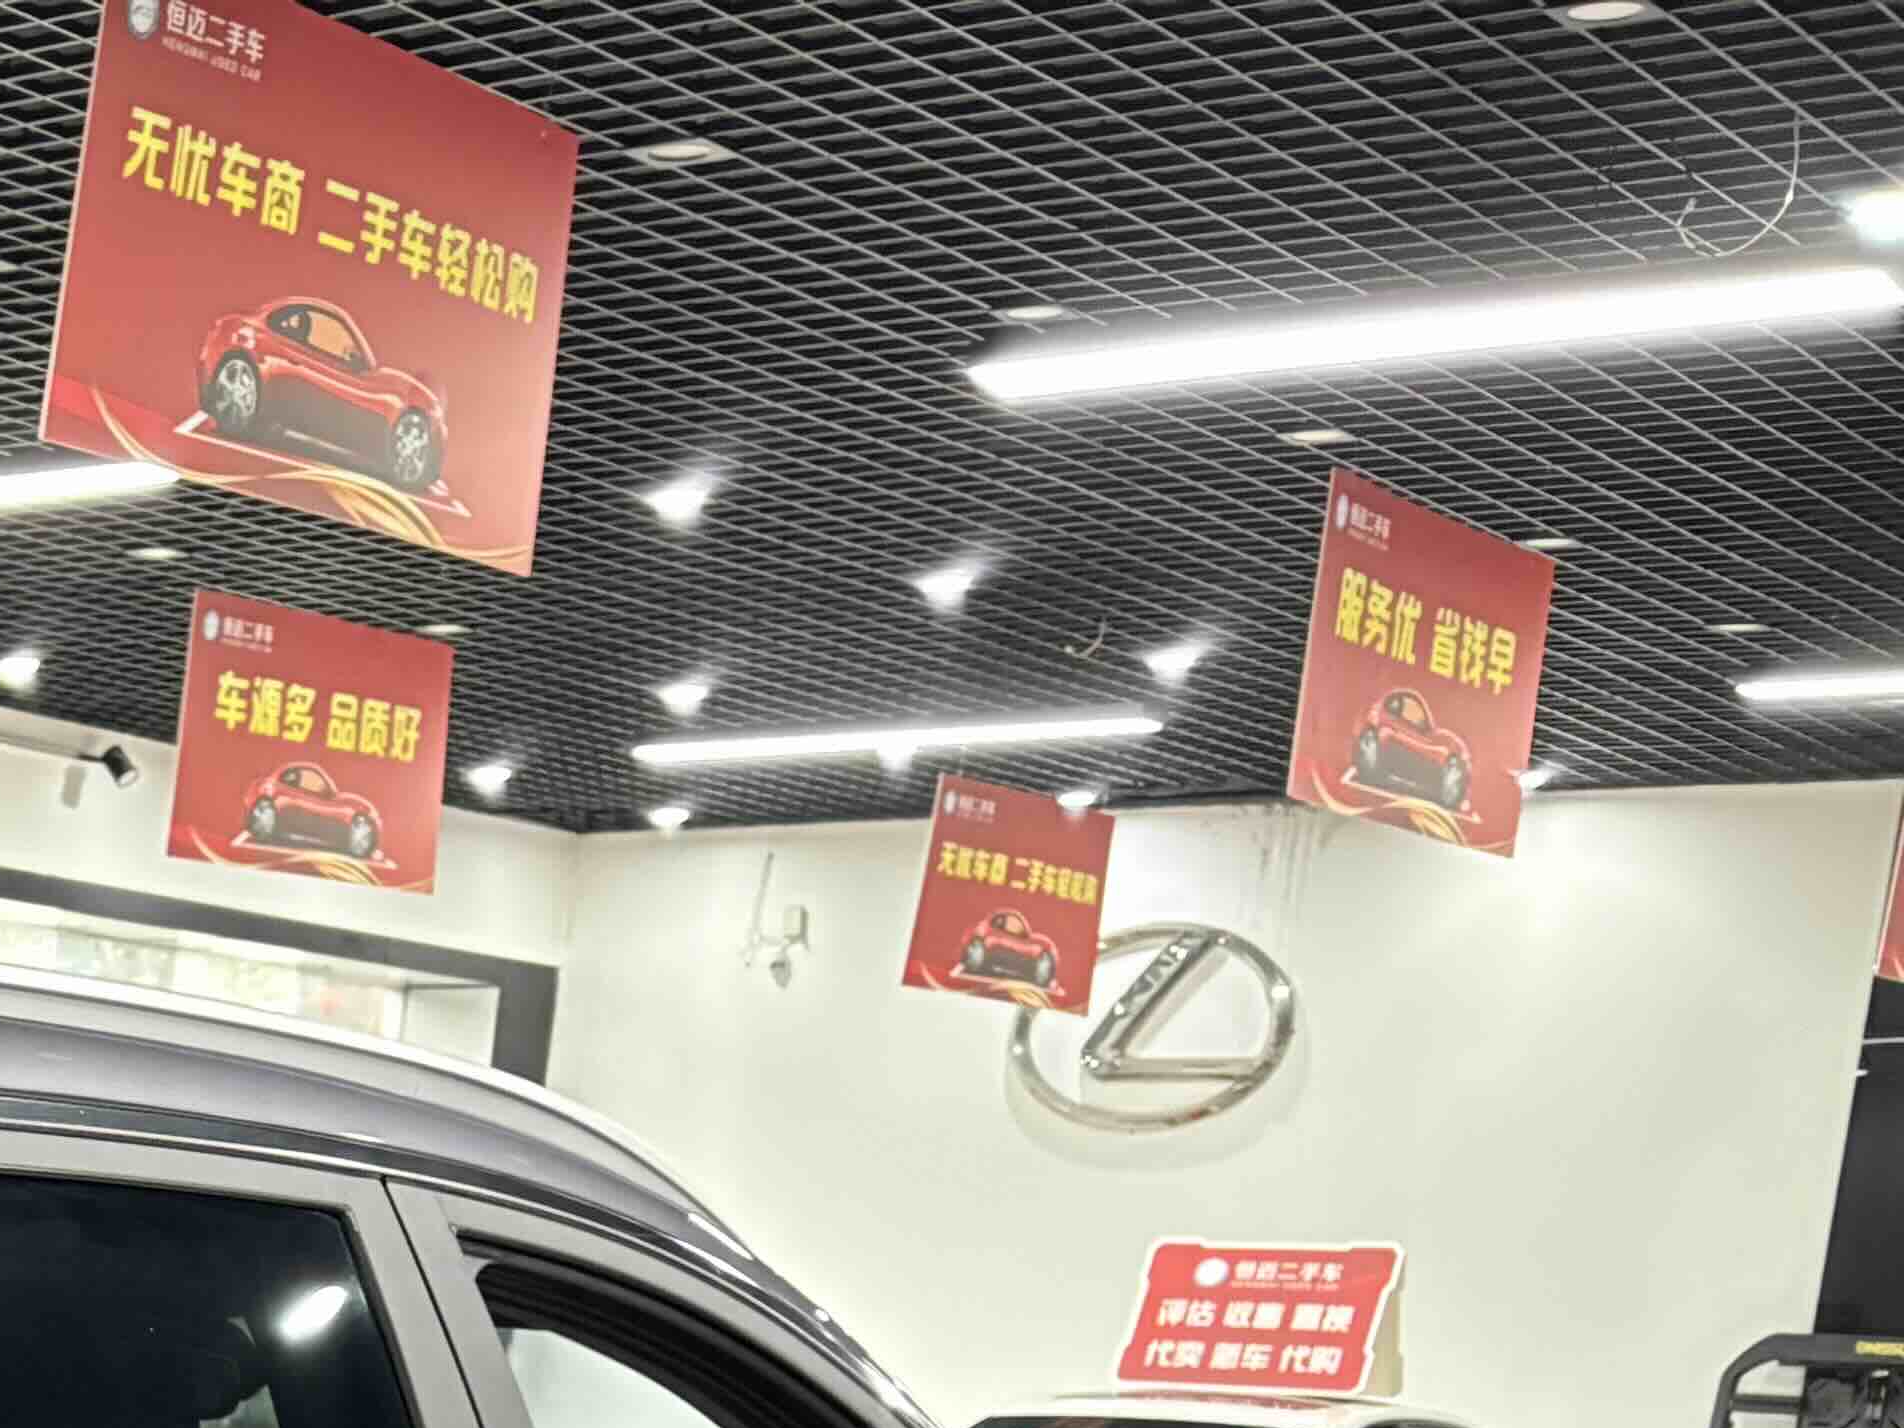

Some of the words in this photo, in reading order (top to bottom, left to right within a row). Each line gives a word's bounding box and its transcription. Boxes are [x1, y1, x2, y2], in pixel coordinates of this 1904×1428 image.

[166, 0, 267, 64] 恒迈二手车
[122, 105, 305, 236] 无忧车商
[317, 178, 540, 324] 二手车轻松购
[1335, 567, 1422, 665] 服务优
[1430, 607, 1517, 695] 省钱早
[214, 669, 316, 743] 车源多
[325, 691, 423, 763] 品质好
